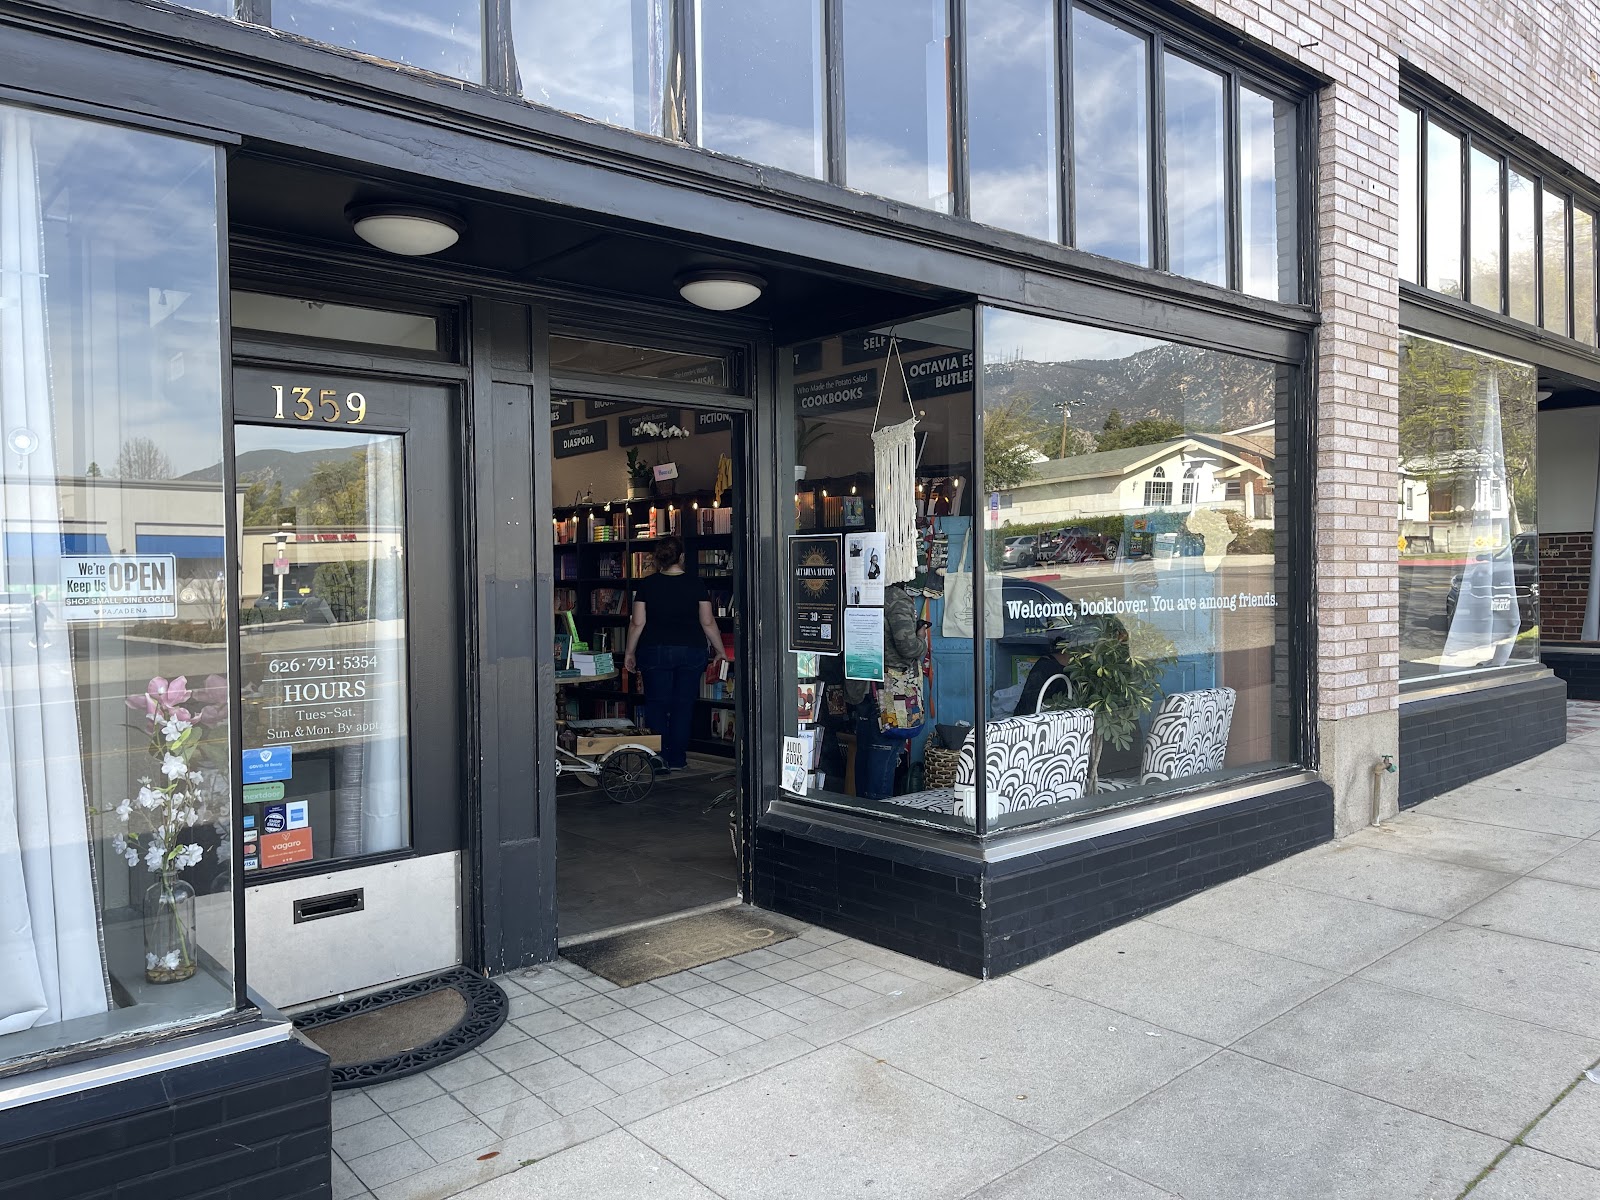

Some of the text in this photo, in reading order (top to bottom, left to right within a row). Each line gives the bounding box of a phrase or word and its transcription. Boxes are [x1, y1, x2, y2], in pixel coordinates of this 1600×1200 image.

[863, 336, 886, 350] SELF
[909, 357, 959, 377] OCTAVIA
[796, 373, 868, 395] Who Made the Potato Salad
[271, 385, 366, 424] 1359
[801, 387, 863, 409] COOKBOOKS
[563, 434, 594, 449] DIASPORA
[78, 562, 166, 592] We're OPEN
[67, 579, 106, 594] Keep Us
[66, 598, 90, 606] SHOP
[1006, 592, 1279, 620] Welcome, booklover. You are among friends.
[102, 607, 148, 615] PASADENA
[284, 680, 366, 703] HOURS
[338, 722, 352, 734] By
[786, 741, 802, 754] AUDIO
[785, 753, 804, 766] BOOKS
[244, 791, 281, 800] nextdoor
[272, 840, 301, 851] vagaro
